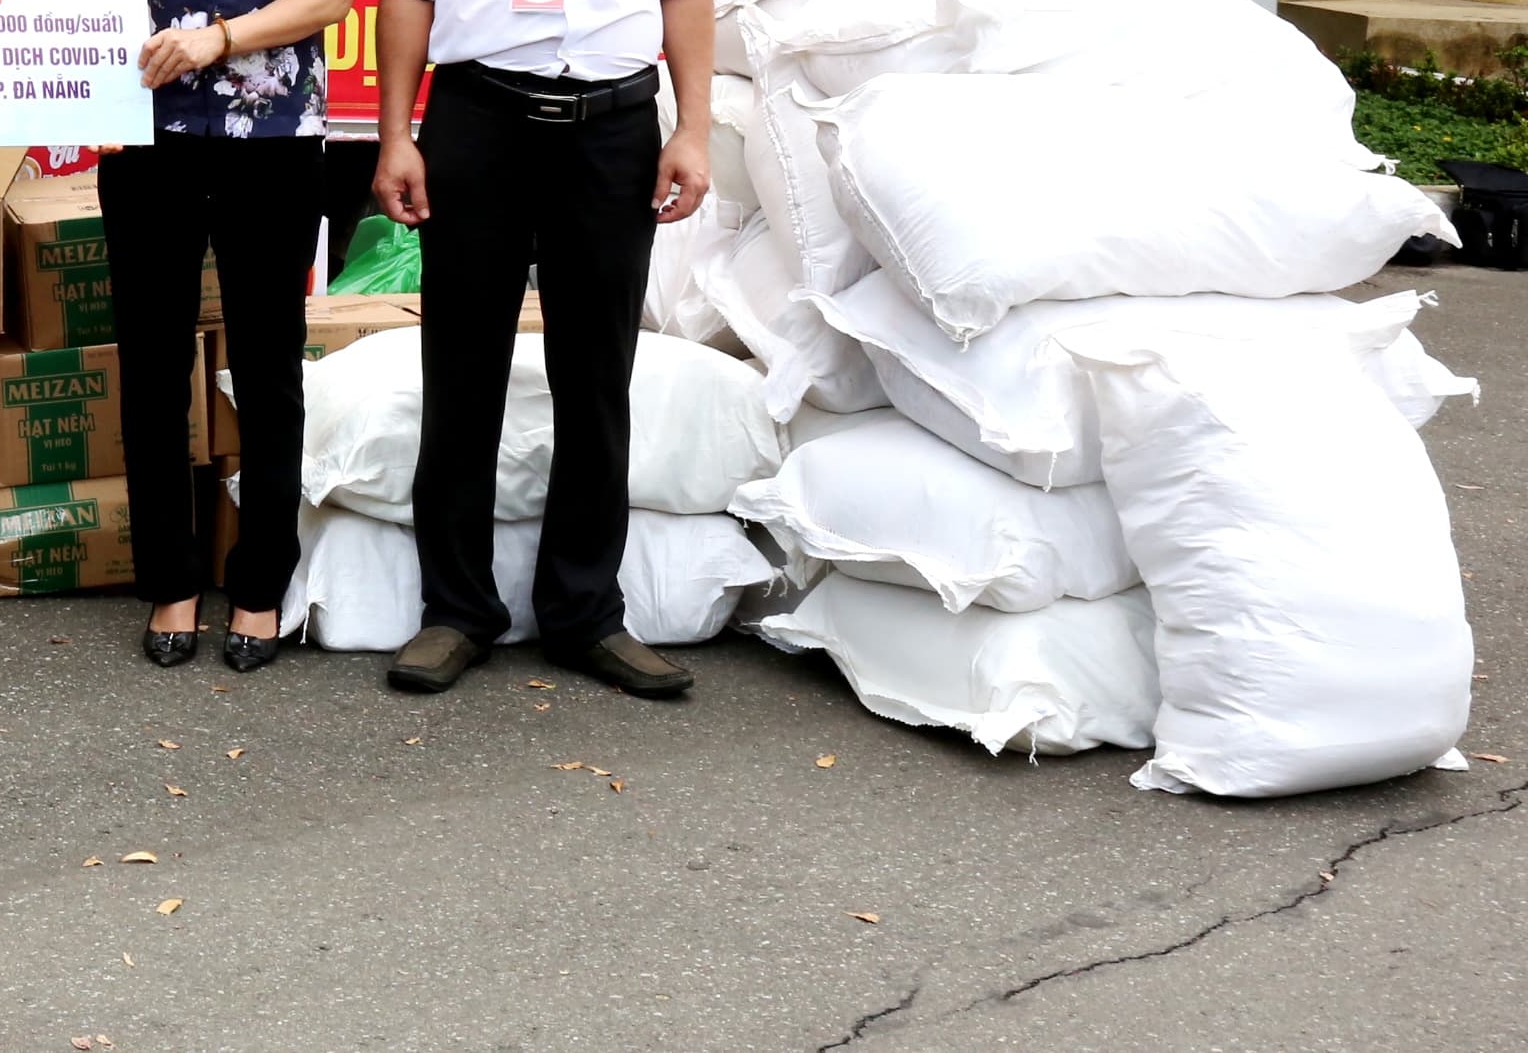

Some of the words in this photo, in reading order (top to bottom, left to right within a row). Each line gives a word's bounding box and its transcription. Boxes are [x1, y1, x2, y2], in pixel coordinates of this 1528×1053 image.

[33, 11, 124, 35] đồng/suất)
[2, 47, 43, 70] DỊCH
[49, 47, 127, 66] COVID-19
[13, 76, 36, 100] ĐÀ
[42, 242, 109, 265] MEIZ
[54, 281, 86, 301] HẠT
[92, 277, 112, 296] NÊ
[8, 376, 102, 401] MEIZAN
[19, 418, 52, 438] HẠT
[57, 414, 94, 434] NÊM
[0, 506, 94, 535] MEIZAN
[50, 543, 87, 563] NÊM
